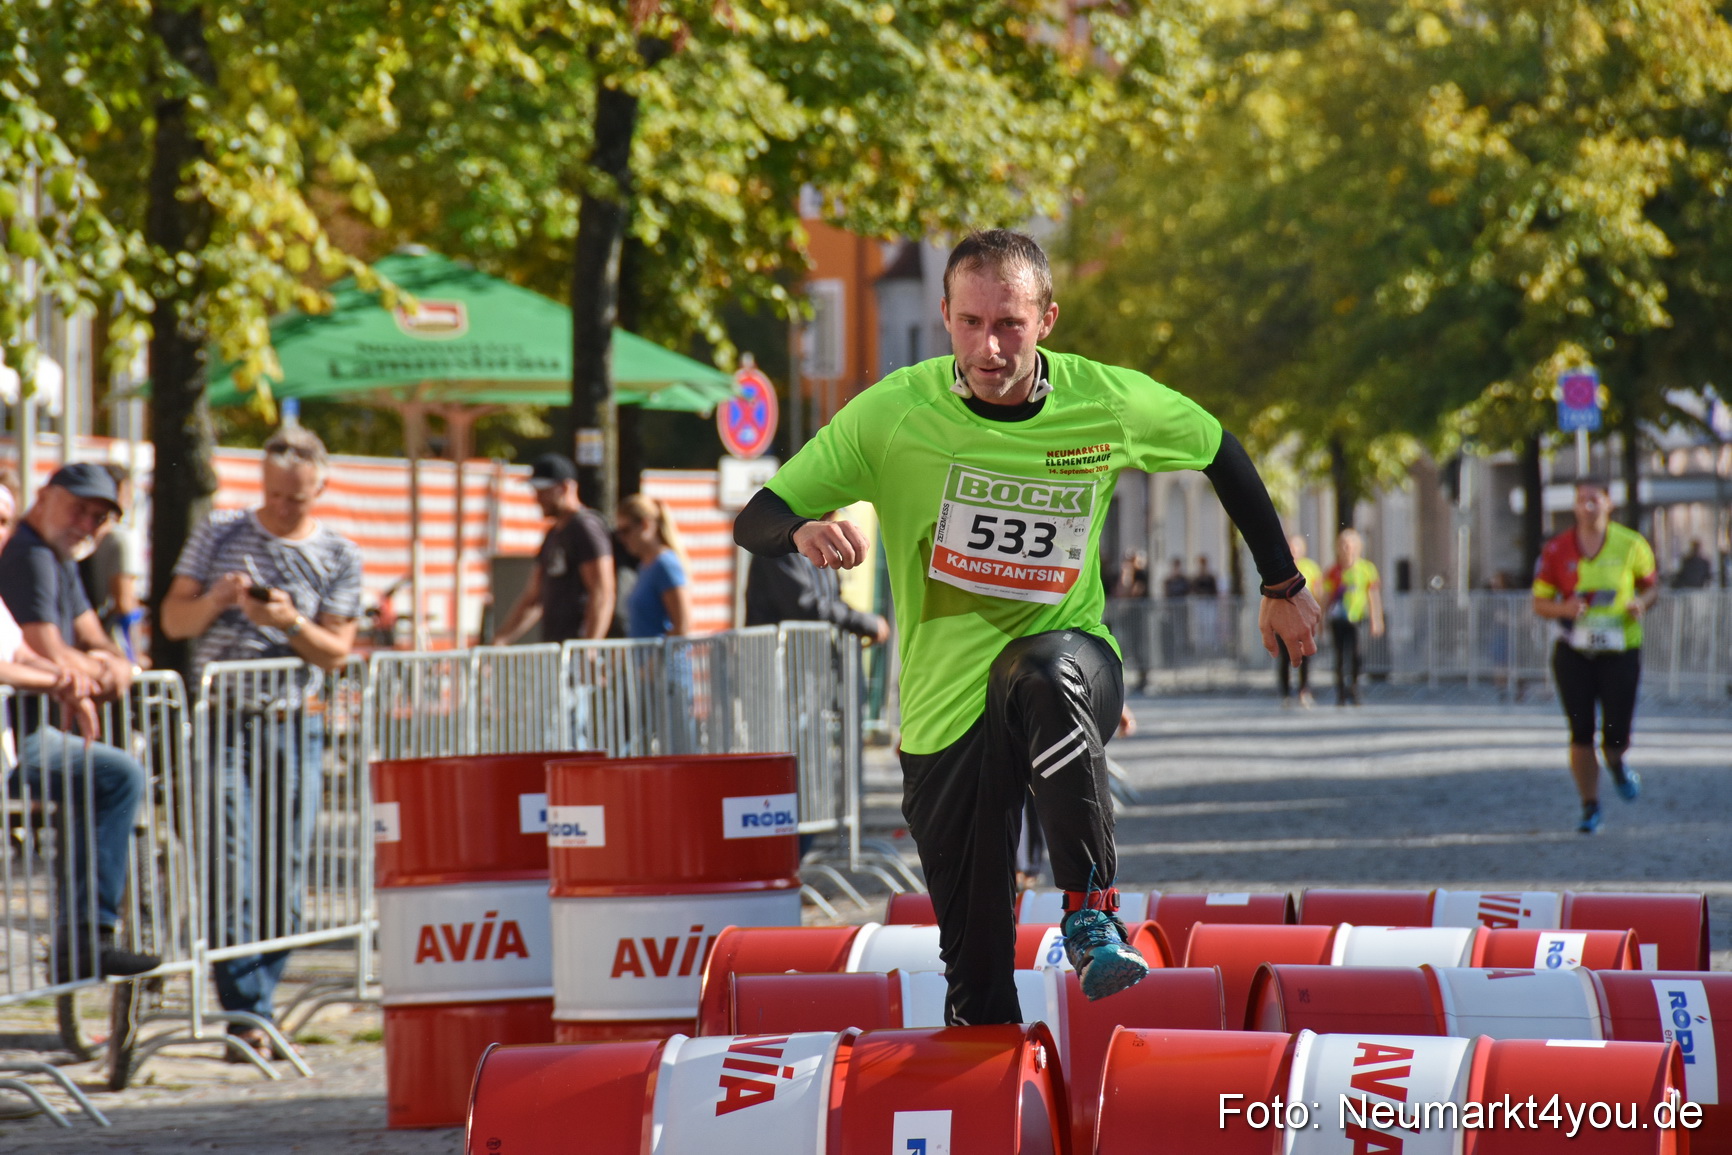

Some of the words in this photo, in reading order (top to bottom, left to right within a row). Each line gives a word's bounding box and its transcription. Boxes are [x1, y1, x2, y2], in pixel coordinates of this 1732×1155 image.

[1046, 453, 1112, 467] ELEMENTELAUF
[1047, 444, 1111, 458] NEUMARKTER
[1096, 465, 1109, 473] 2019
[957, 473, 1083, 513] BOCK
[967, 514, 1057, 559] 533
[946, 553, 1066, 584] KANSTANTSIN
